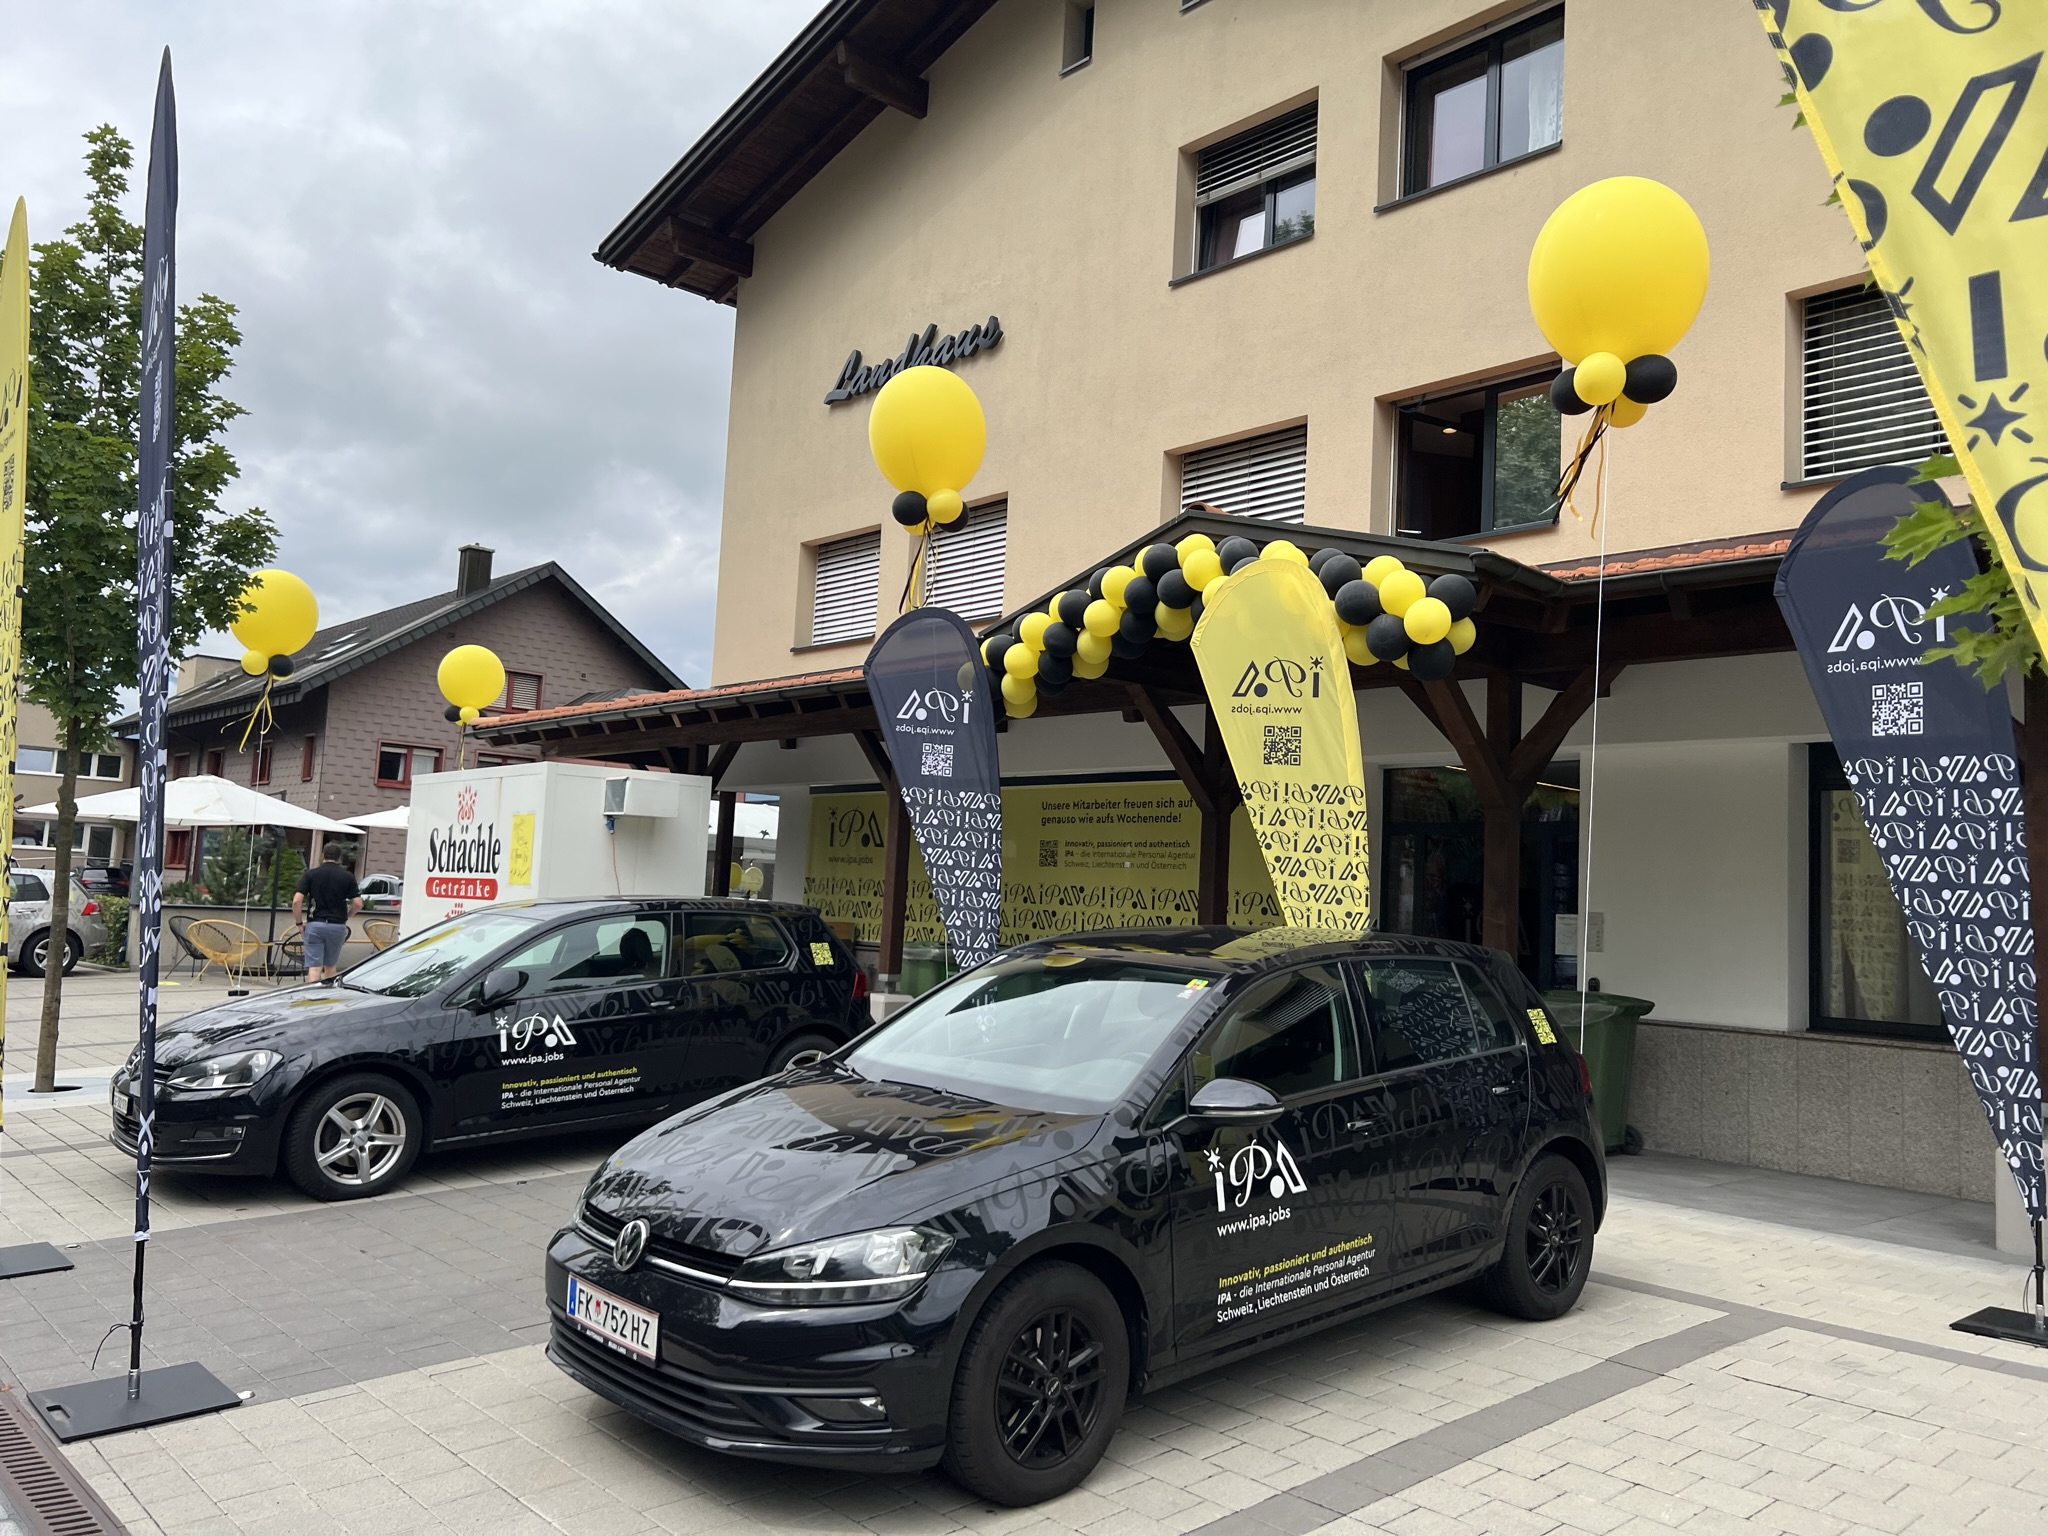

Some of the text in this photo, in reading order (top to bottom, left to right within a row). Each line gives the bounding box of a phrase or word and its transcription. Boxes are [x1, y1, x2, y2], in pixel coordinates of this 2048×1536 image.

[824, 315, 1004, 405] Landhaus
[1042, 797, 1194, 811] Unsere Mitarbeiter freuen sich auf
[1041, 812, 1182, 826] genauso wie aufs Wochenende!
[427, 822, 501, 874] Schächle
[1080, 850, 1091, 858] die
[1137, 850, 1166, 859] Personal
[1167, 851, 1196, 861] Agentur
[1096, 840, 1132, 850] passioniert
[1134, 839, 1147, 848] und
[1149, 839, 1190, 848] authentisch
[1136, 861, 1149, 869] und
[432, 879, 490, 898] Getränke
[502, 1052, 565, 1066] www.ipa.jobs
[501, 1091, 514, 1100] IPA
[520, 1089, 532, 1098] die
[533, 1082, 582, 1096] Internationale
[584, 1078, 613, 1089] Personal
[614, 1075, 642, 1087] Agentur
[502, 1066, 638, 1090] Innovativ, passioniert und authentisch
[501, 1084, 635, 1110] Schweiz, Liechtenstein und Österreich
[1216, 1206, 1291, 1237] www.ipa.jobs
[1218, 1232, 1373, 1289] Innovativ, passioniert und authentisch
[1217, 1291, 1232, 1306] IPA
[1239, 1285, 1254, 1300] die
[1255, 1267, 1312, 1294] Internationale
[1313, 1257, 1346, 1277] Personal
[1346, 1248, 1376, 1267] Agentur
[1257, 1284, 1313, 1310] Liechtenstein
[1314, 1276, 1330, 1292] und
[1330, 1263, 1370, 1287] Österreich
[577, 1287, 593, 1321] FK
